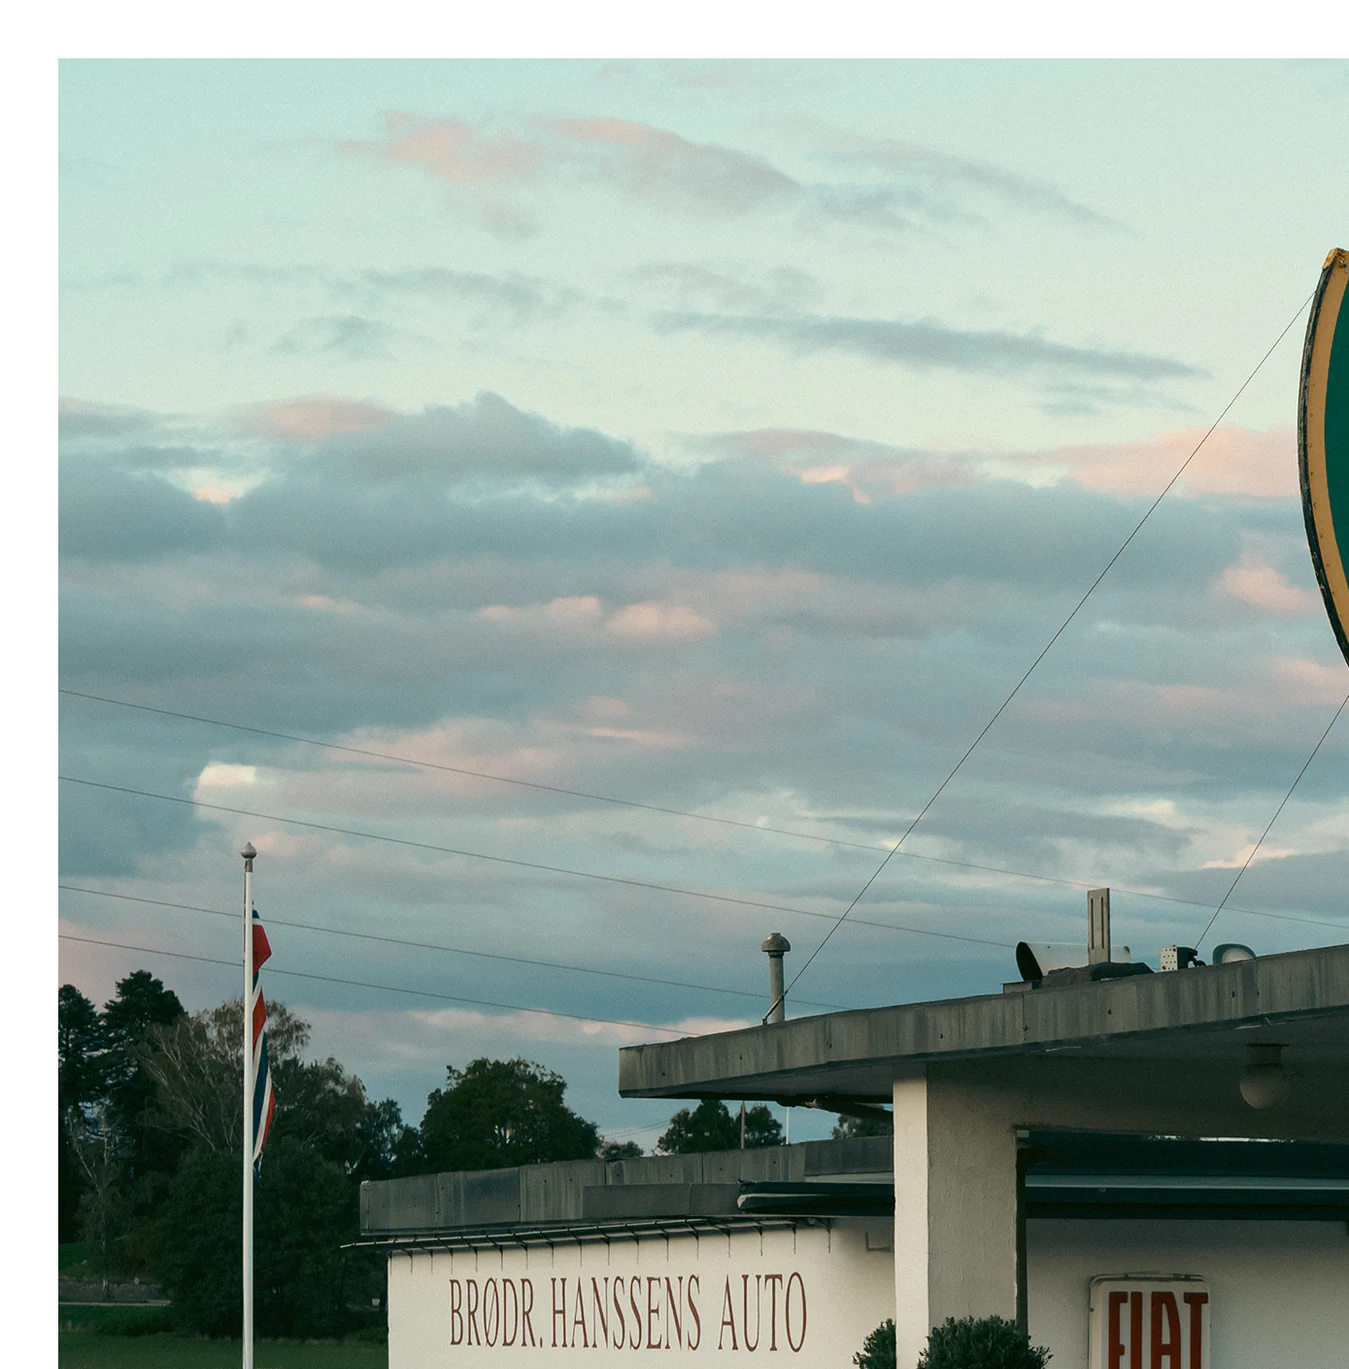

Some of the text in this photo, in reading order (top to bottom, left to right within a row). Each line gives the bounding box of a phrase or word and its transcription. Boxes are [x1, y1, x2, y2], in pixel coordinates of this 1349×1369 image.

[449, 1272, 808, 1353] BRØDR. HANSSENS AUTO
